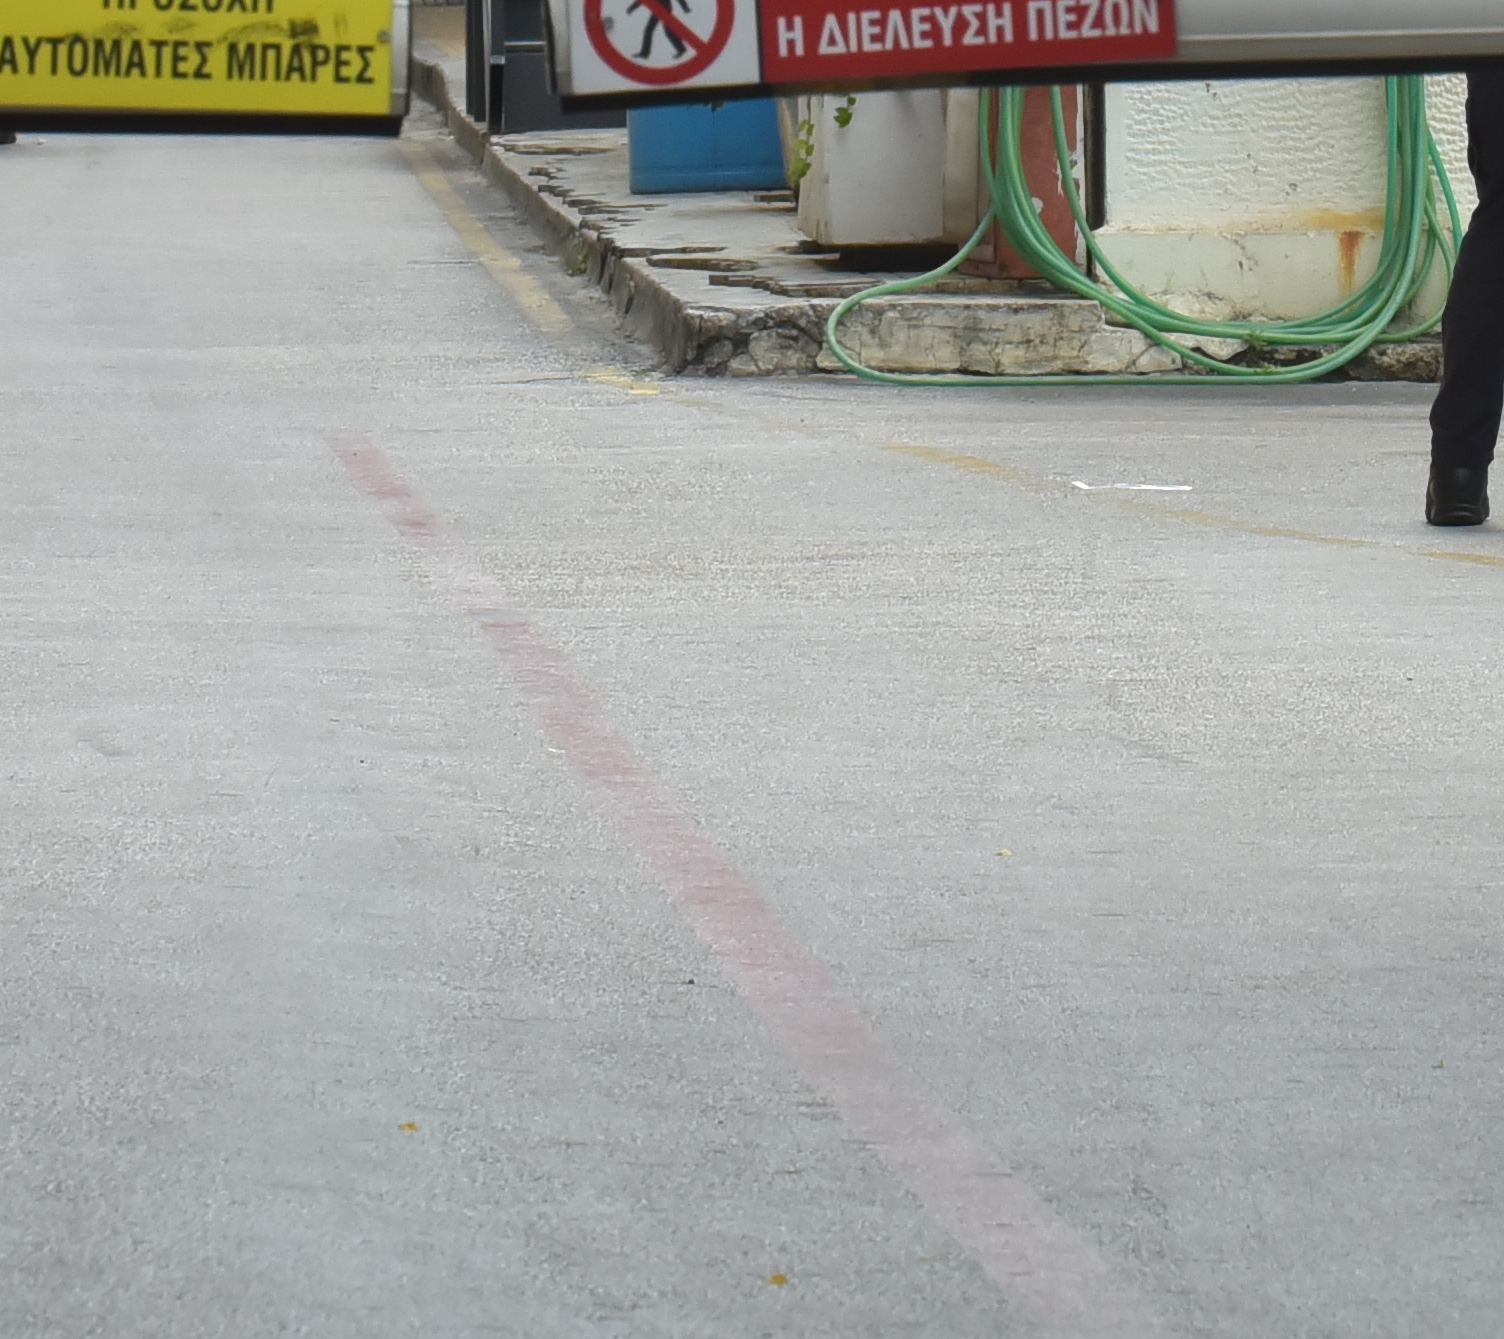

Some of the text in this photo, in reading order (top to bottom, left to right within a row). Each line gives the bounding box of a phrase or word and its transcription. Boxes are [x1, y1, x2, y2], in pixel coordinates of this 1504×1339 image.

[776, 15, 804, 57] Η
[817, 1, 1014, 55] ΔΙΕΛΕΥΣΗ
[226, 42, 376, 85] ΜΠΑΡΕΣ
